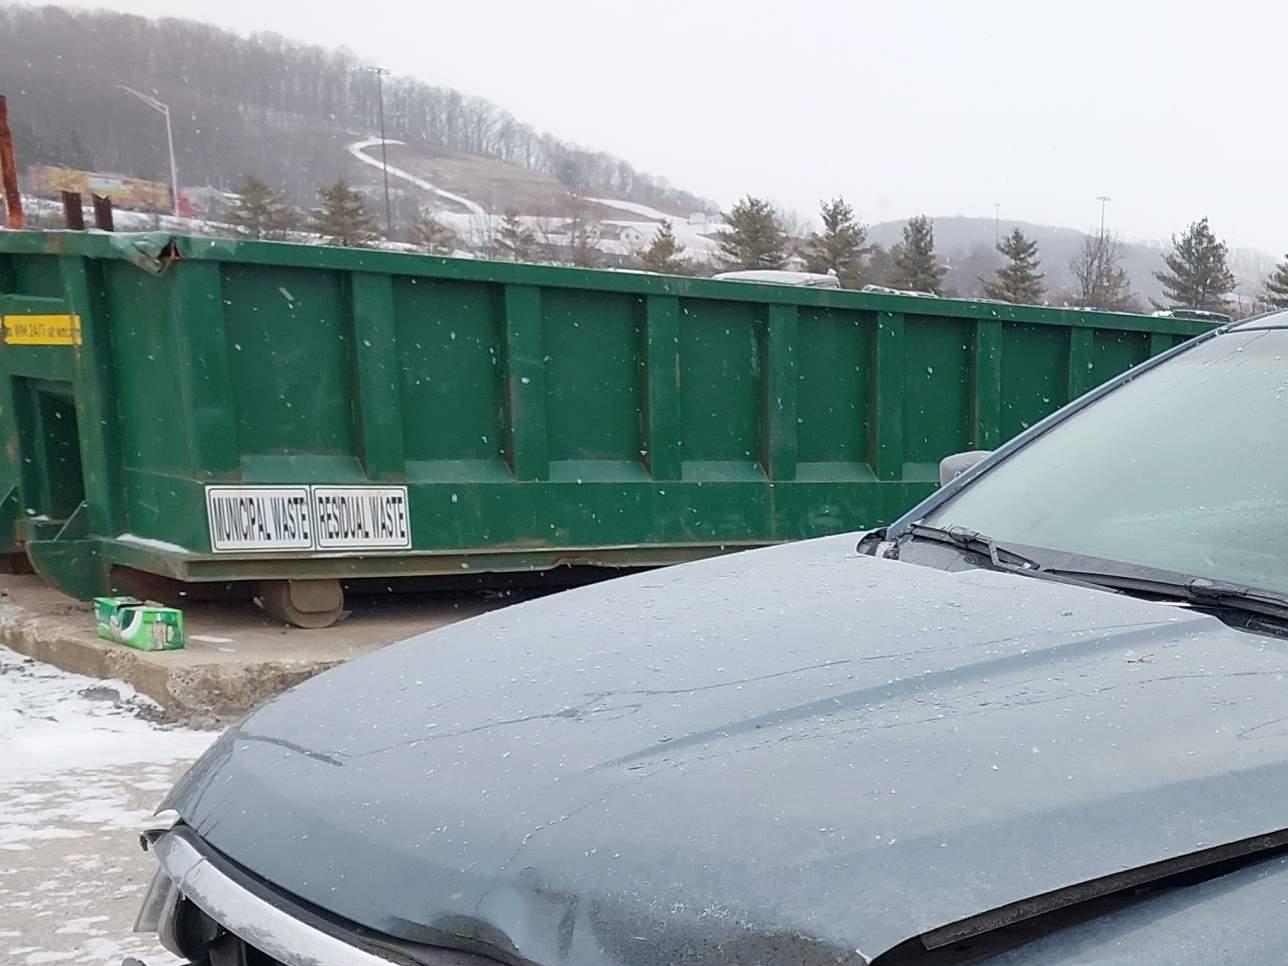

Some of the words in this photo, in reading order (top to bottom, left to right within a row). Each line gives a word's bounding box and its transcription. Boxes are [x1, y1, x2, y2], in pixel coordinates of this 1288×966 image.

[212, 497, 271, 541] MUNICIPAL
[270, 497, 308, 540] WASTE
[318, 496, 369, 539] RESIDUAL
[368, 496, 405, 539] WASTE
